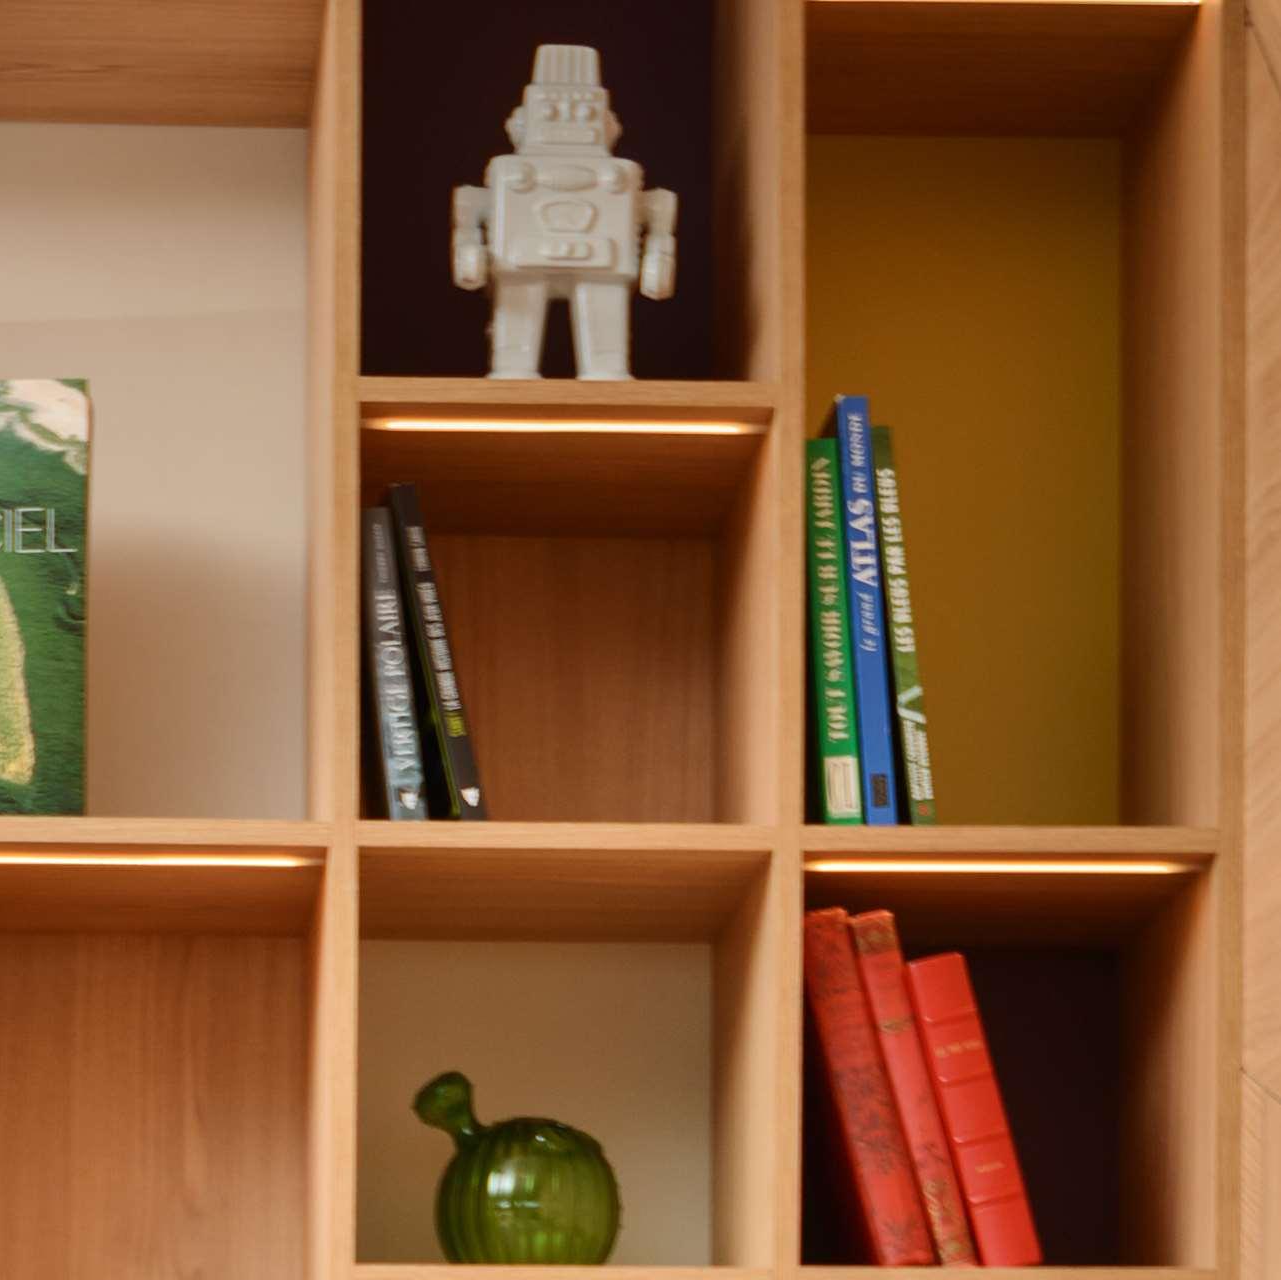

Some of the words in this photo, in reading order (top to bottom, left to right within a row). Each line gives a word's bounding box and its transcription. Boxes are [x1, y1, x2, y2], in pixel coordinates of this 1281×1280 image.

[810, 457, 836, 529] JARDIN
[875, 466, 899, 514] BLEUS
[814, 532, 836, 560] LE
[847, 498, 879, 588] ATLAS
[880, 515, 902, 543] LES
[884, 544, 906, 576] PAR
[818, 564, 840, 606] SUR
[887, 576, 912, 624] BLEUS
[375, 590, 405, 677] POLAIRE
[821, 611, 846, 682] SAVOIR
[893, 625, 916, 653] LES
[387, 684, 415, 771] VERTIGE
[825, 688, 850, 742] TOUT
